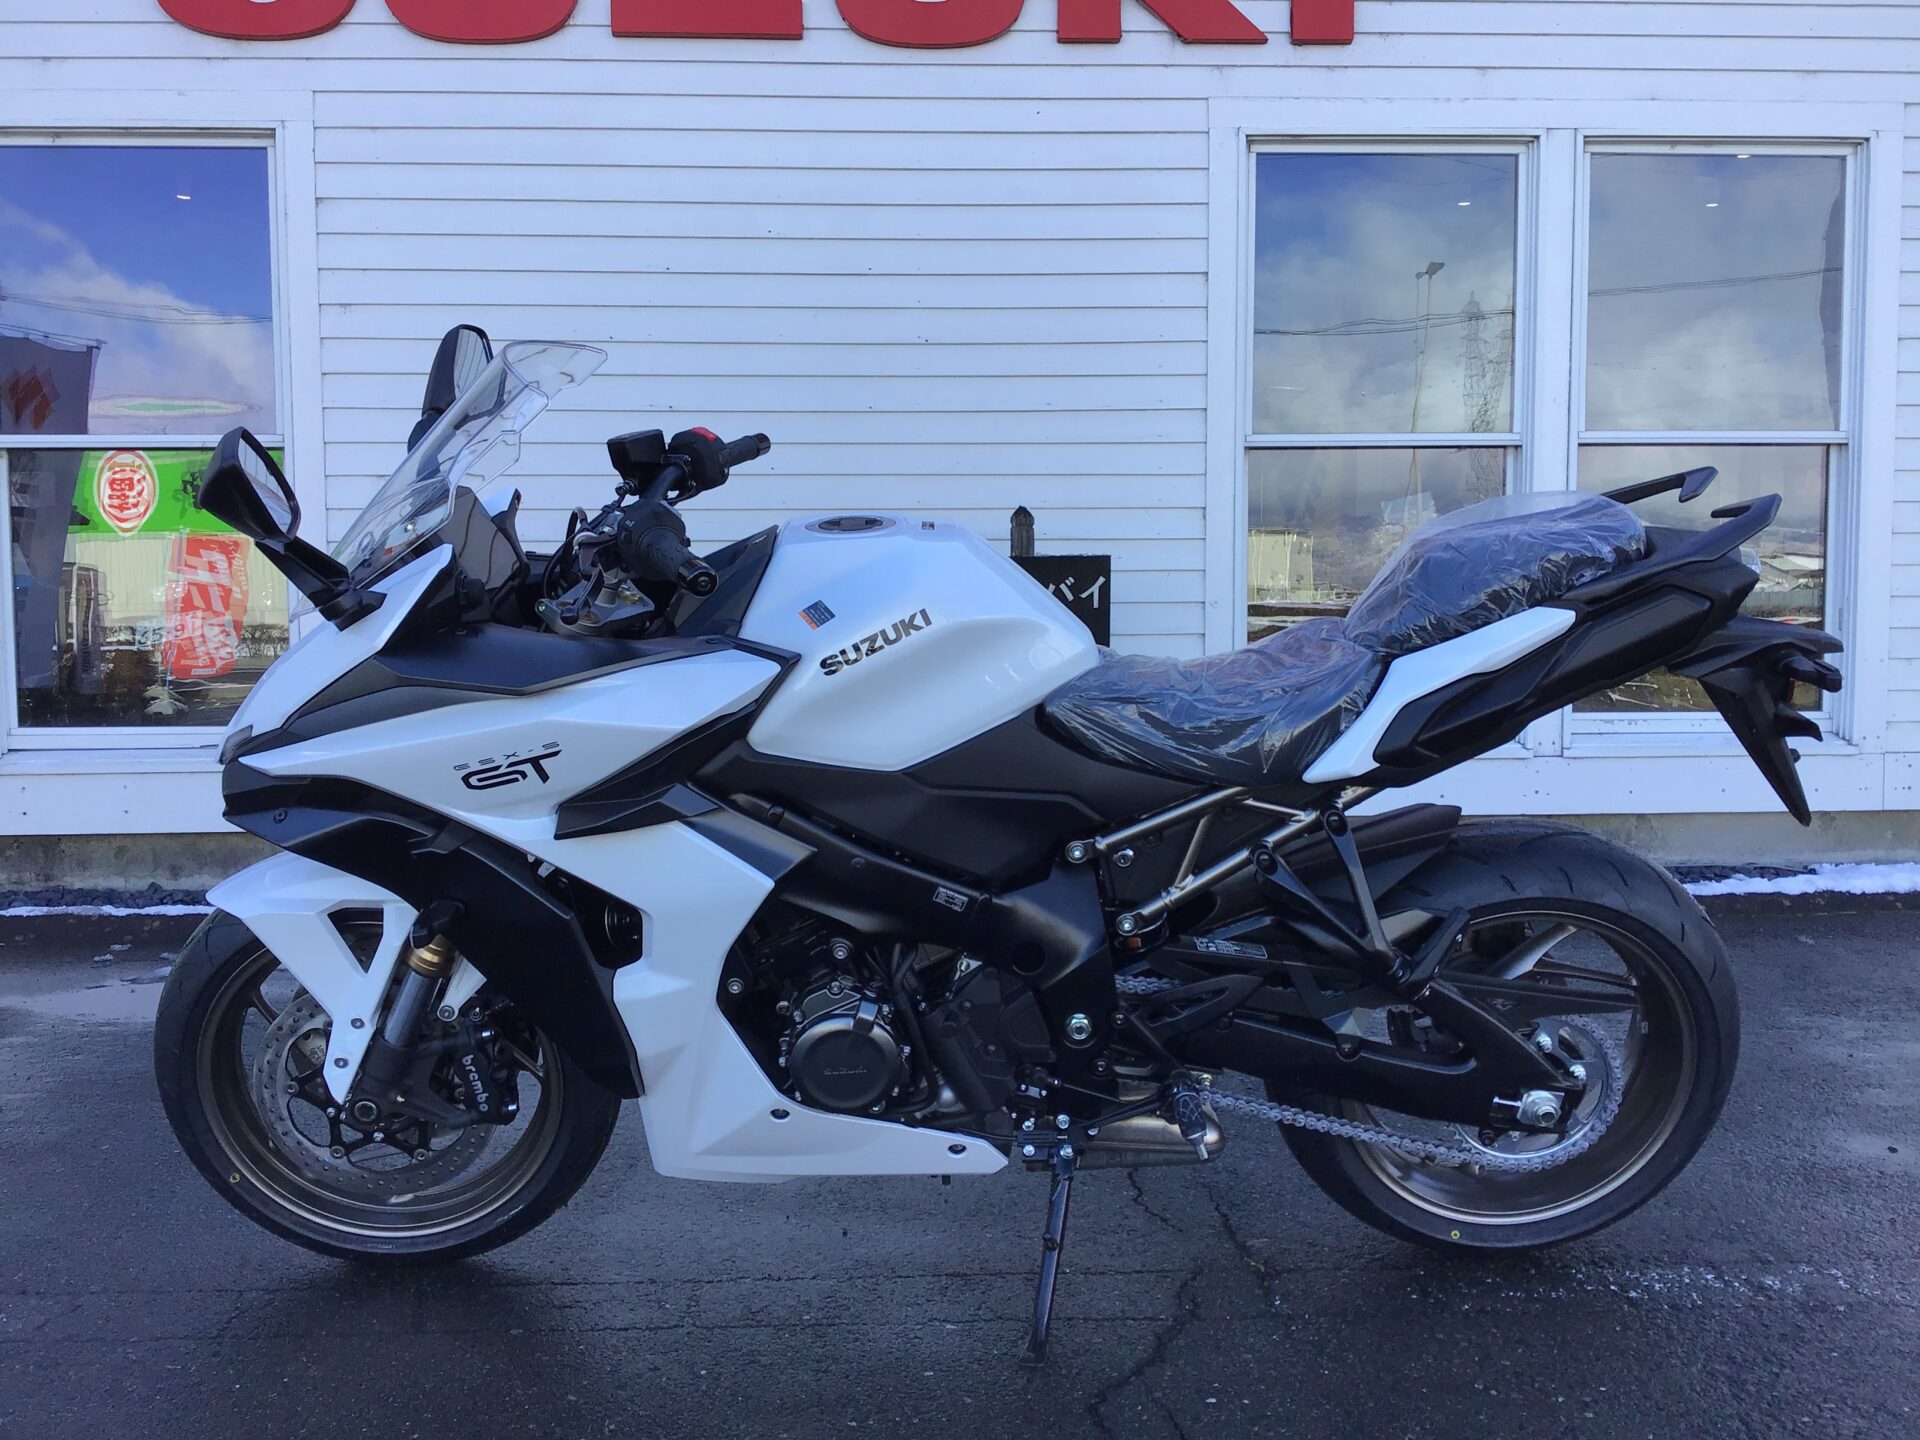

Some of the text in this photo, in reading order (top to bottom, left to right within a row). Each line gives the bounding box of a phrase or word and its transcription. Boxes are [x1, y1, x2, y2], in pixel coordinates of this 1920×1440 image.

[820, 608, 933, 676] SUZUKI
[453, 741, 560, 771] GSX-S
[461, 749, 562, 790] GT
[462, 1054, 489, 1112] brembo
